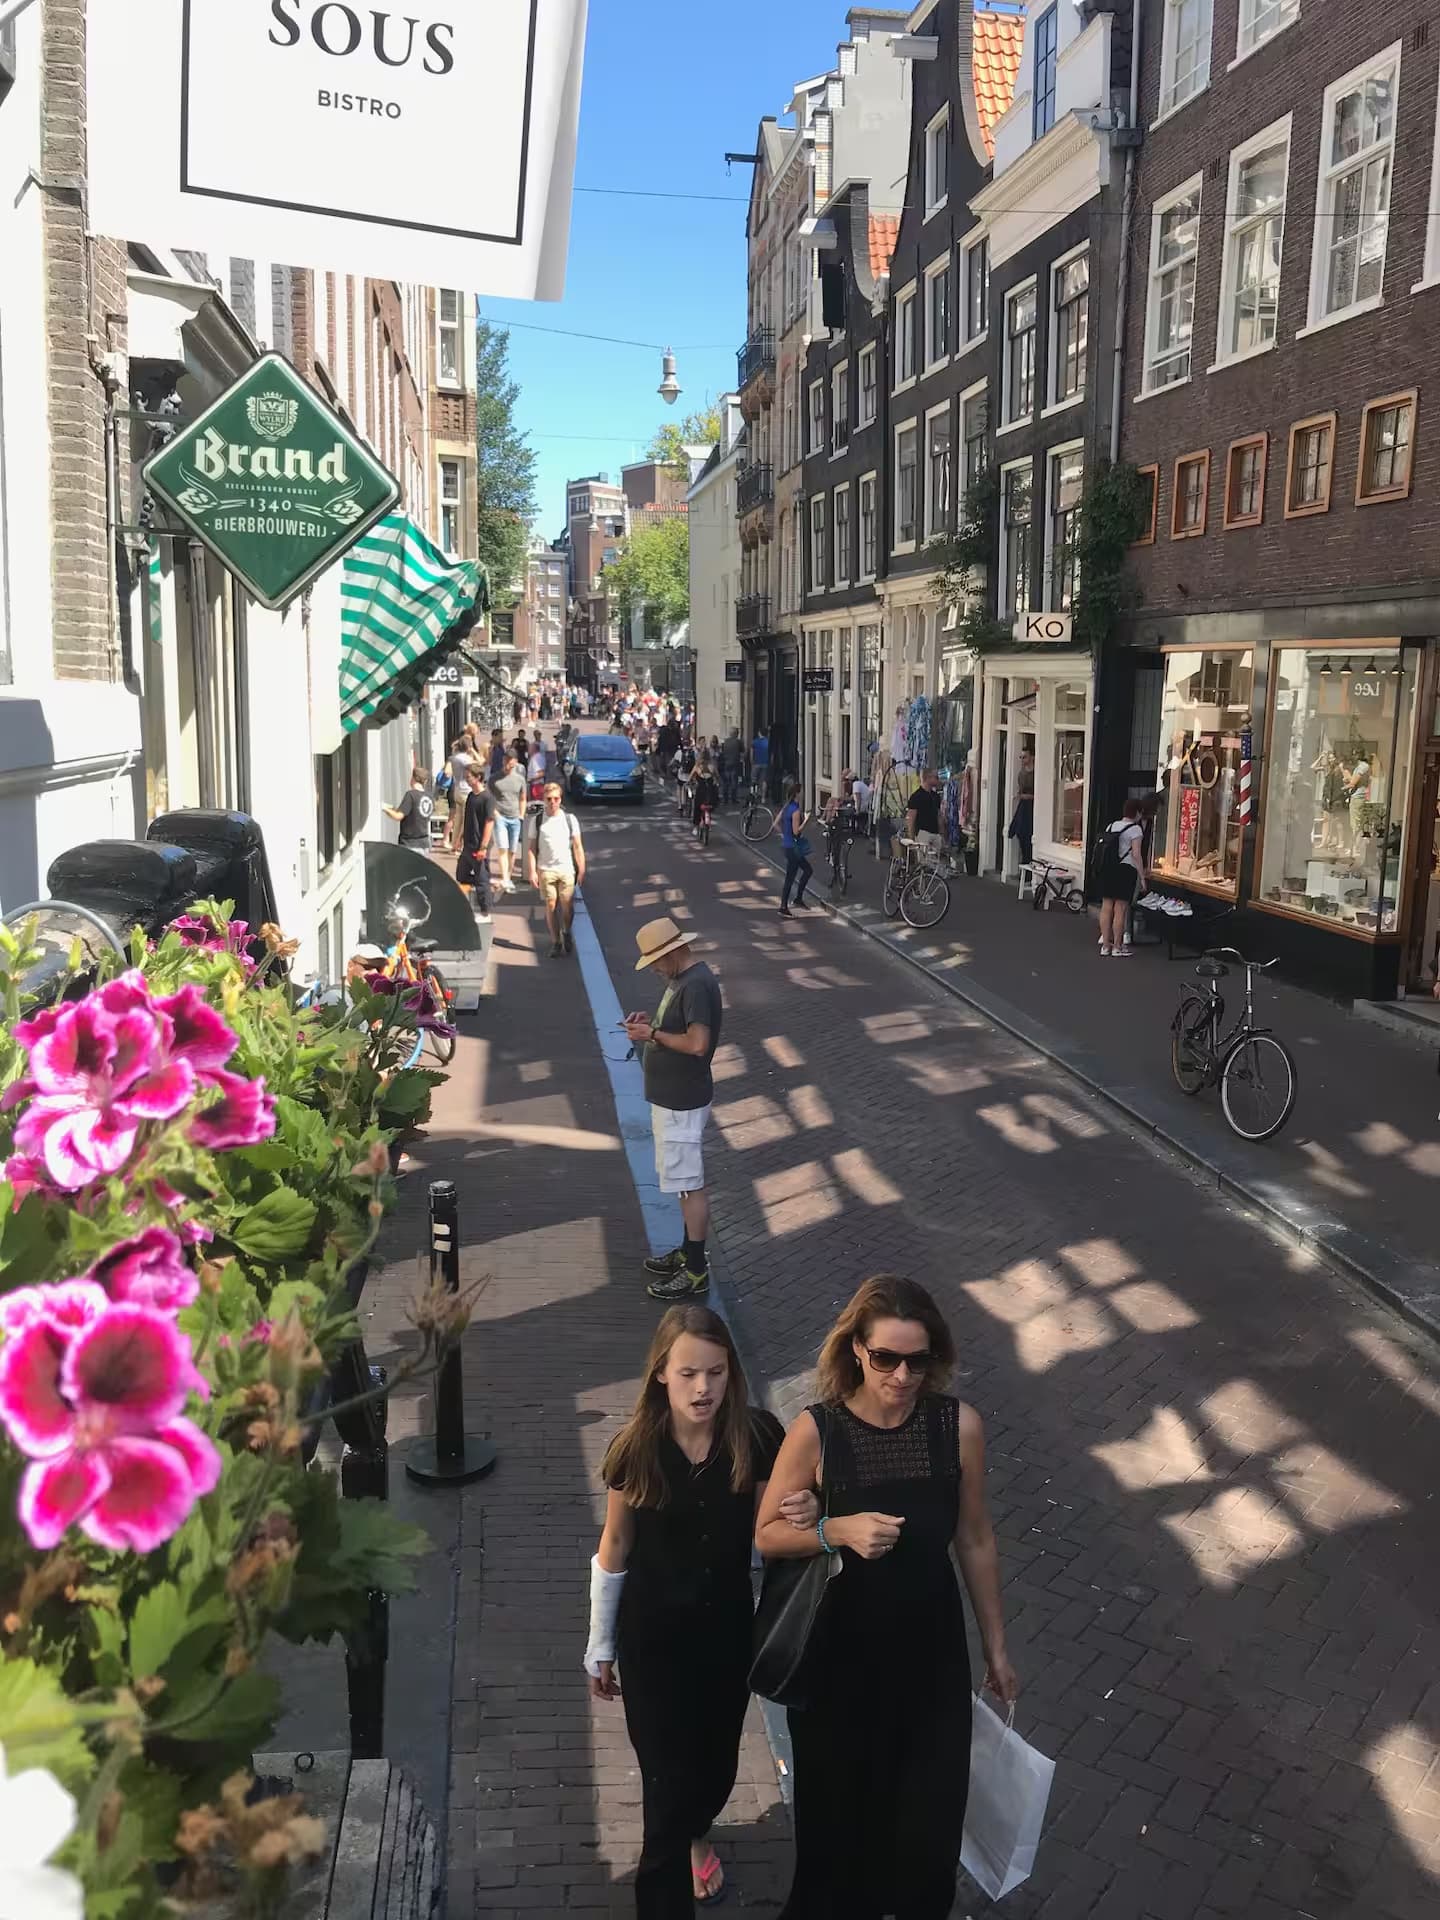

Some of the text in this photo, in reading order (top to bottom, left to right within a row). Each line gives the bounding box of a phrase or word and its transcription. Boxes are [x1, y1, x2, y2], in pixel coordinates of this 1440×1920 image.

[269, 0, 453, 74] SOUS
[318, 89, 401, 119] BISTRO
[194, 426, 350, 485] Brand
[250, 498, 292, 513] 1340
[215, 516, 327, 538] BIERBROUWERIJ
